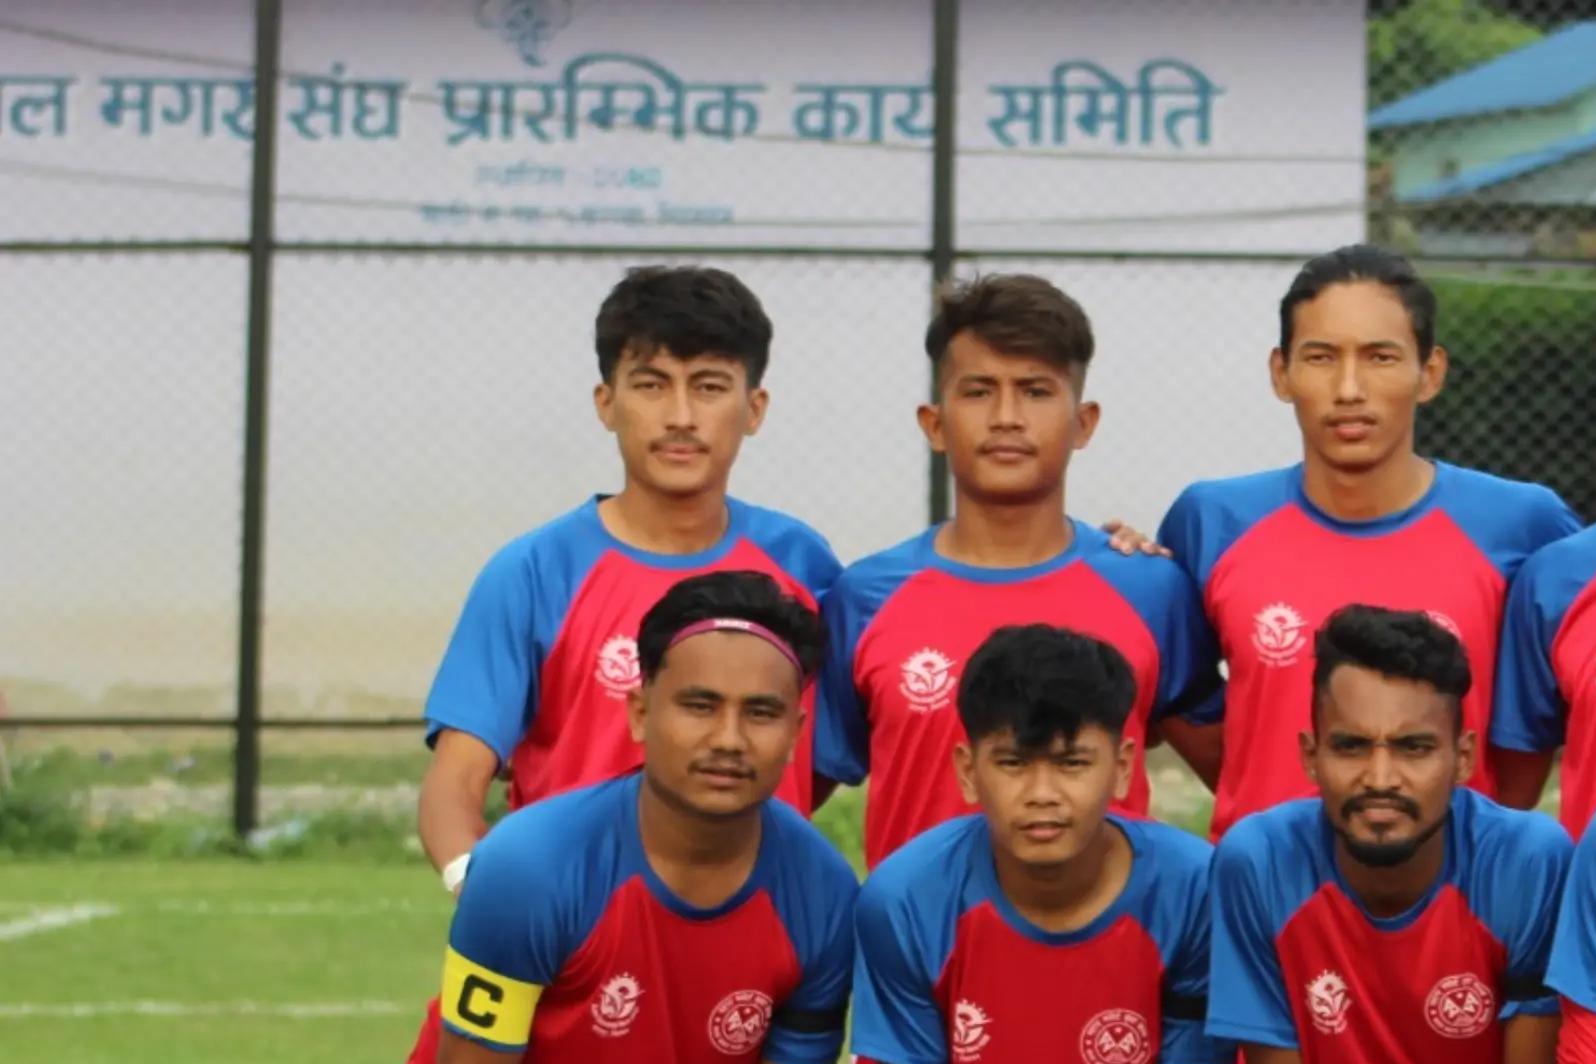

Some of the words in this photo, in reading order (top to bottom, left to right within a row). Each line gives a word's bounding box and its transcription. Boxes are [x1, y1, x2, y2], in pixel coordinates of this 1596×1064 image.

[287, 62, 407, 140] संघ
[986, 57, 1228, 147] समिति
[457, 974, 505, 1029] C
